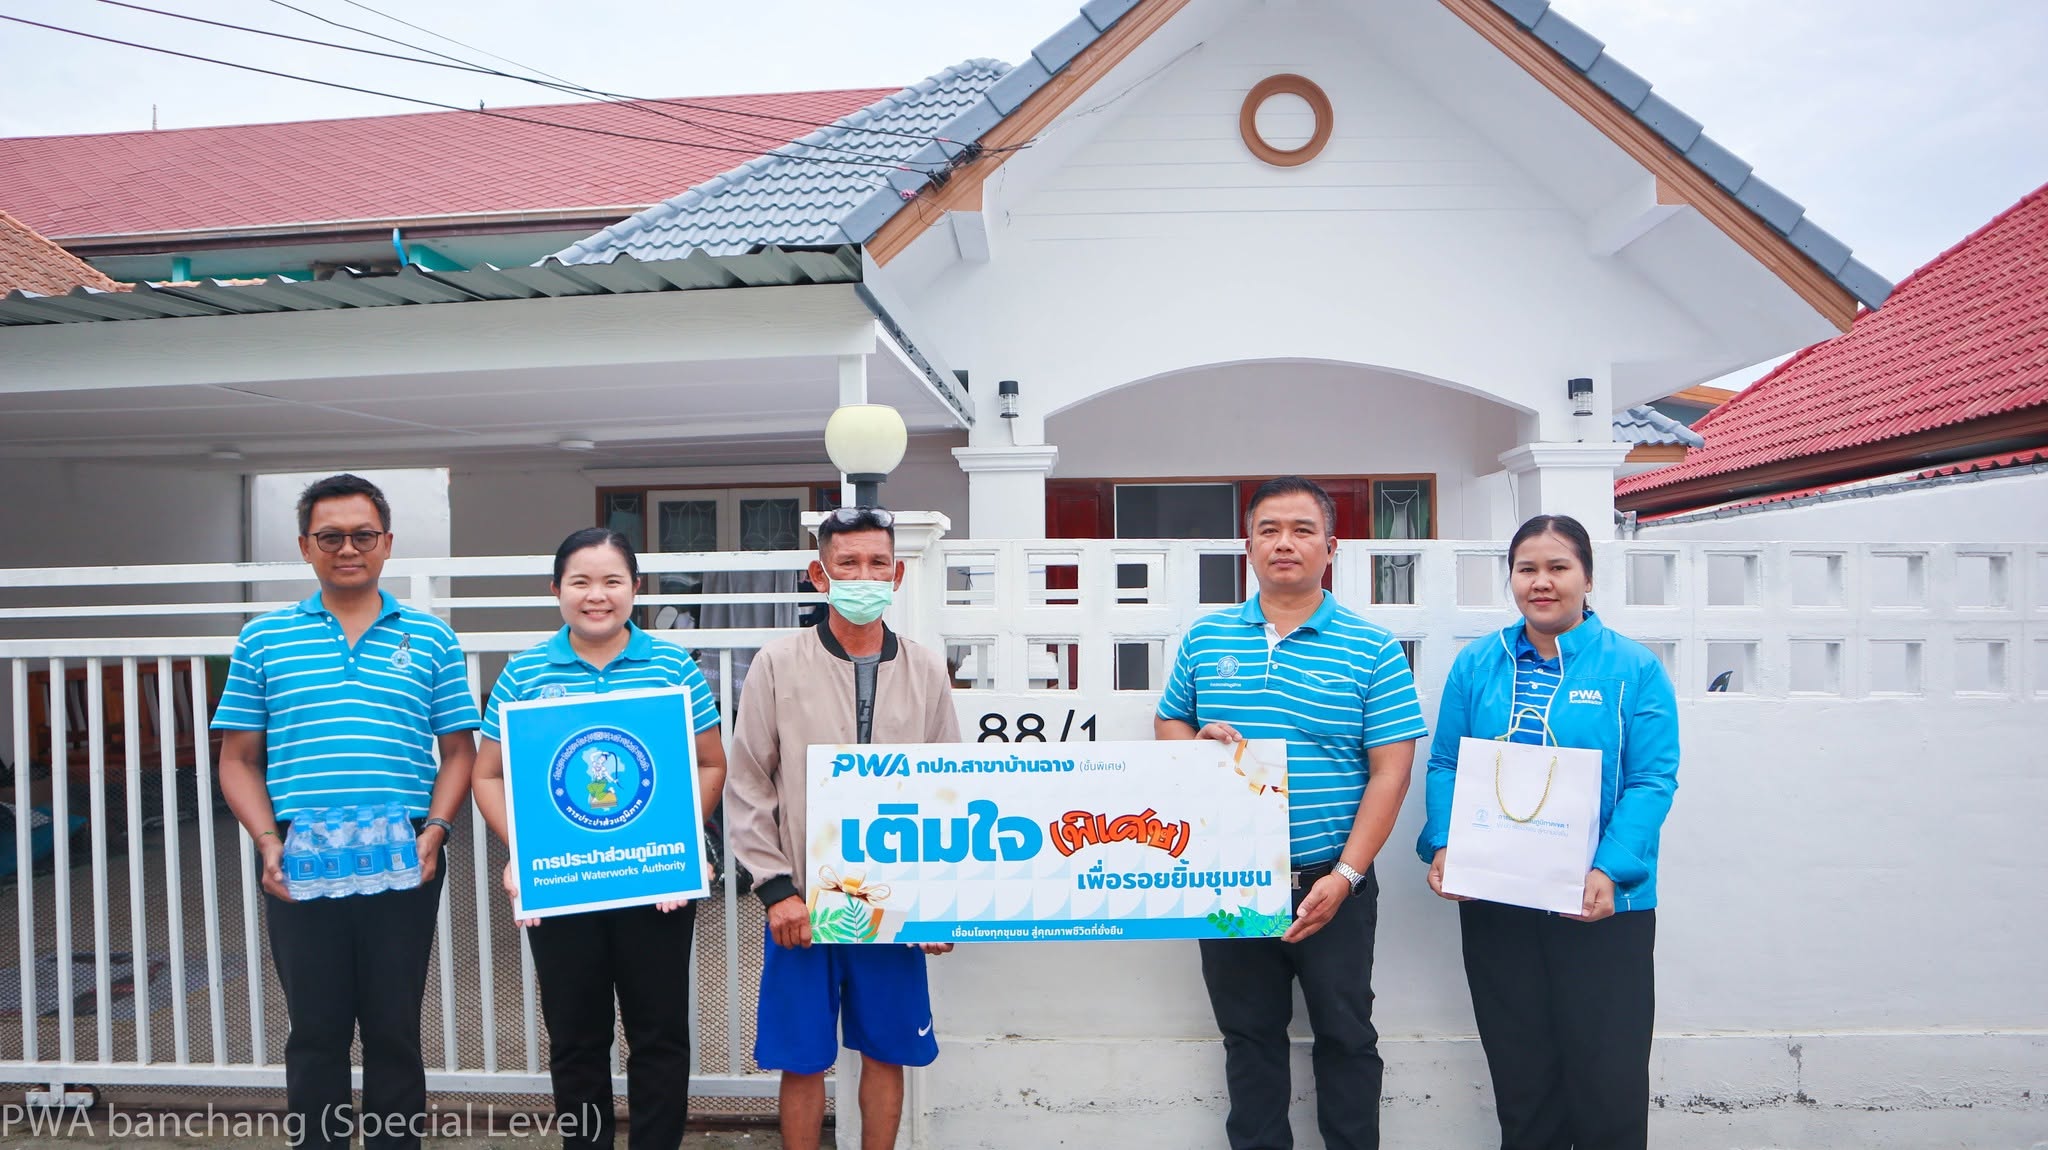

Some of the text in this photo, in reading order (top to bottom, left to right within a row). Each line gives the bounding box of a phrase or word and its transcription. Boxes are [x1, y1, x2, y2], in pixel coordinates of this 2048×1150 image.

[1569, 690, 1603, 701] PWA
[830, 753, 910, 777] PWA
[1079, 760, 1127, 772] (ชั้นพิเศษ)
[841, 799, 1191, 864] เติมใจ (พิเศษ)
[532, 841, 686, 871] การประปาส่วนภูมิภาค
[533, 860, 687, 887] Provincial Waterworks Authority
[1077, 859, 1272, 896] เพื่อรอยยิ้มชุมชน
[951, 923, 1123, 939] เชื่อมโยงทุกชุมชน สู่คุณภาพชีวิตที่ยั่งยืน
